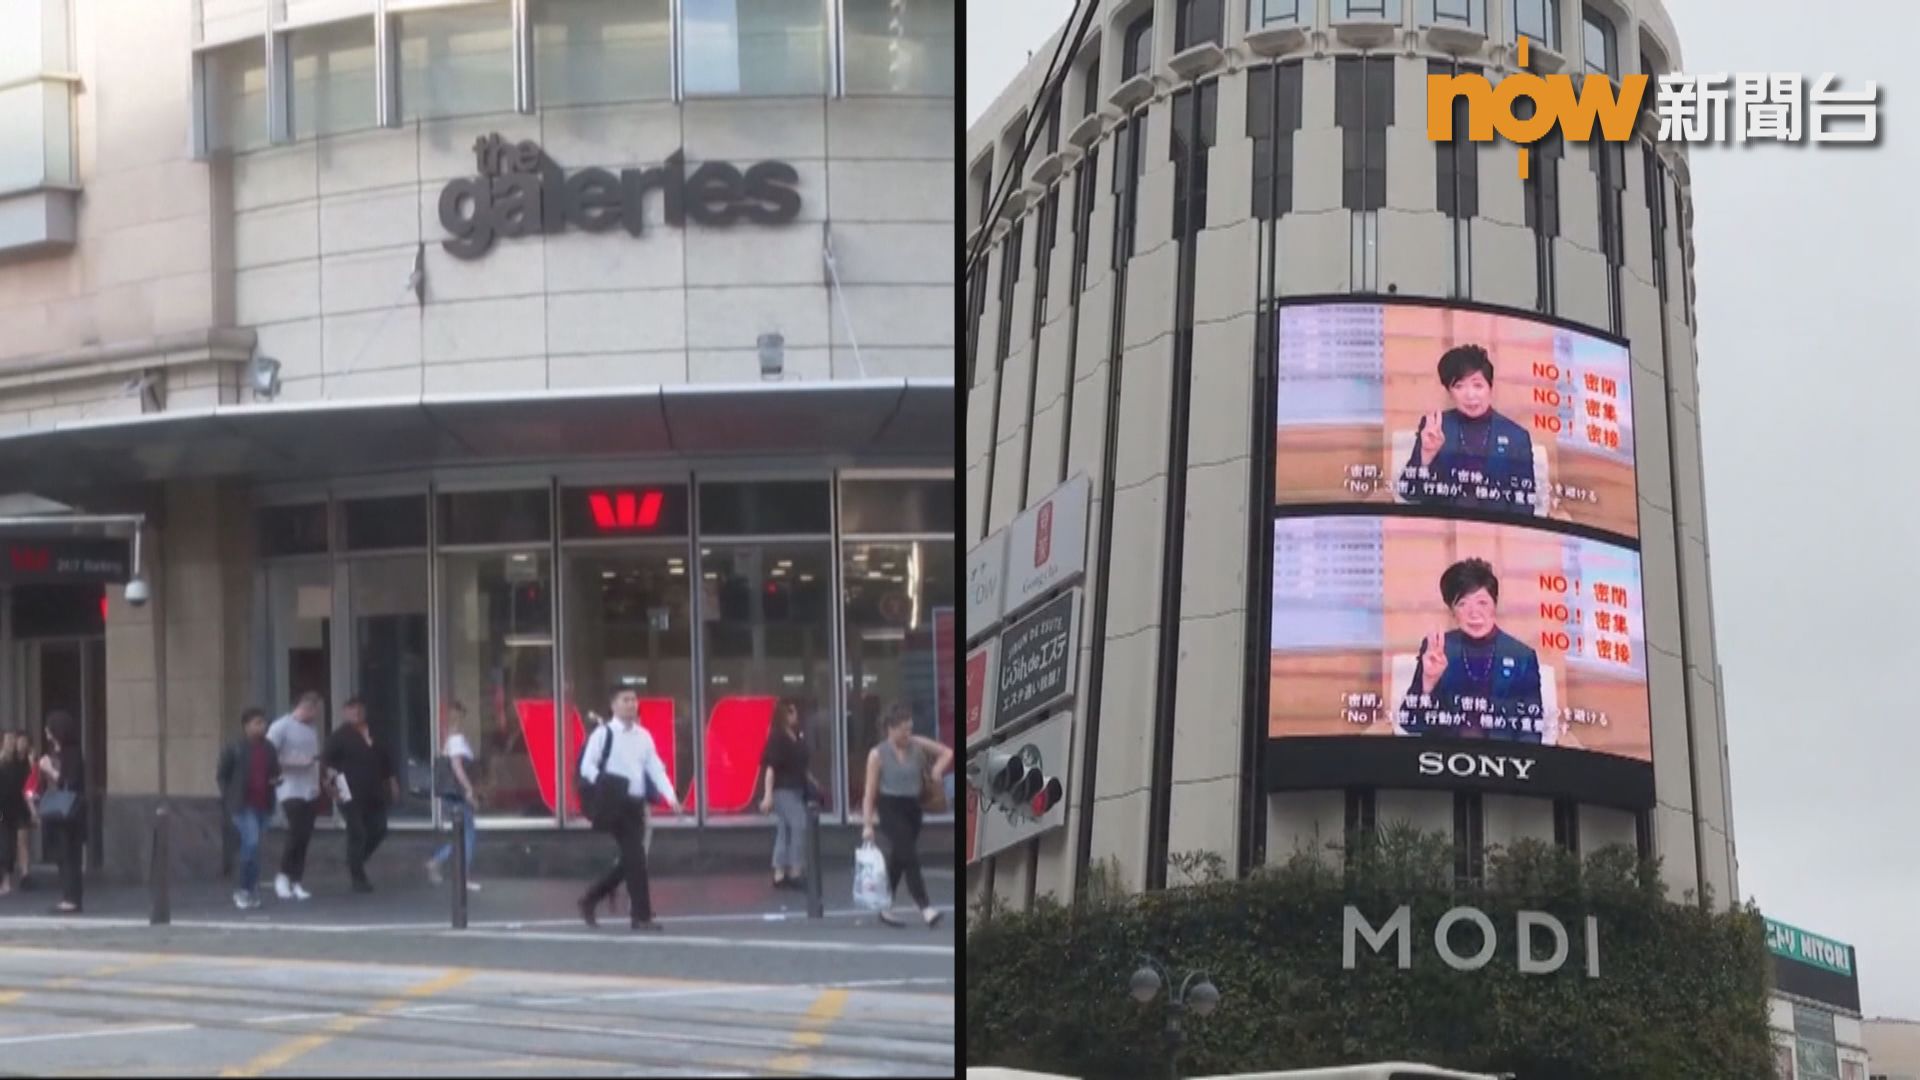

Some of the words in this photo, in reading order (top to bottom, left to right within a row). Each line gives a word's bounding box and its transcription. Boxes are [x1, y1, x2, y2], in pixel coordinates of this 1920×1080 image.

[472, 132, 543, 174] the
[1418, 752, 1536, 779] SONY
[1342, 905, 1600, 978] MODI
[1800, 933, 1850, 969] NITORI
